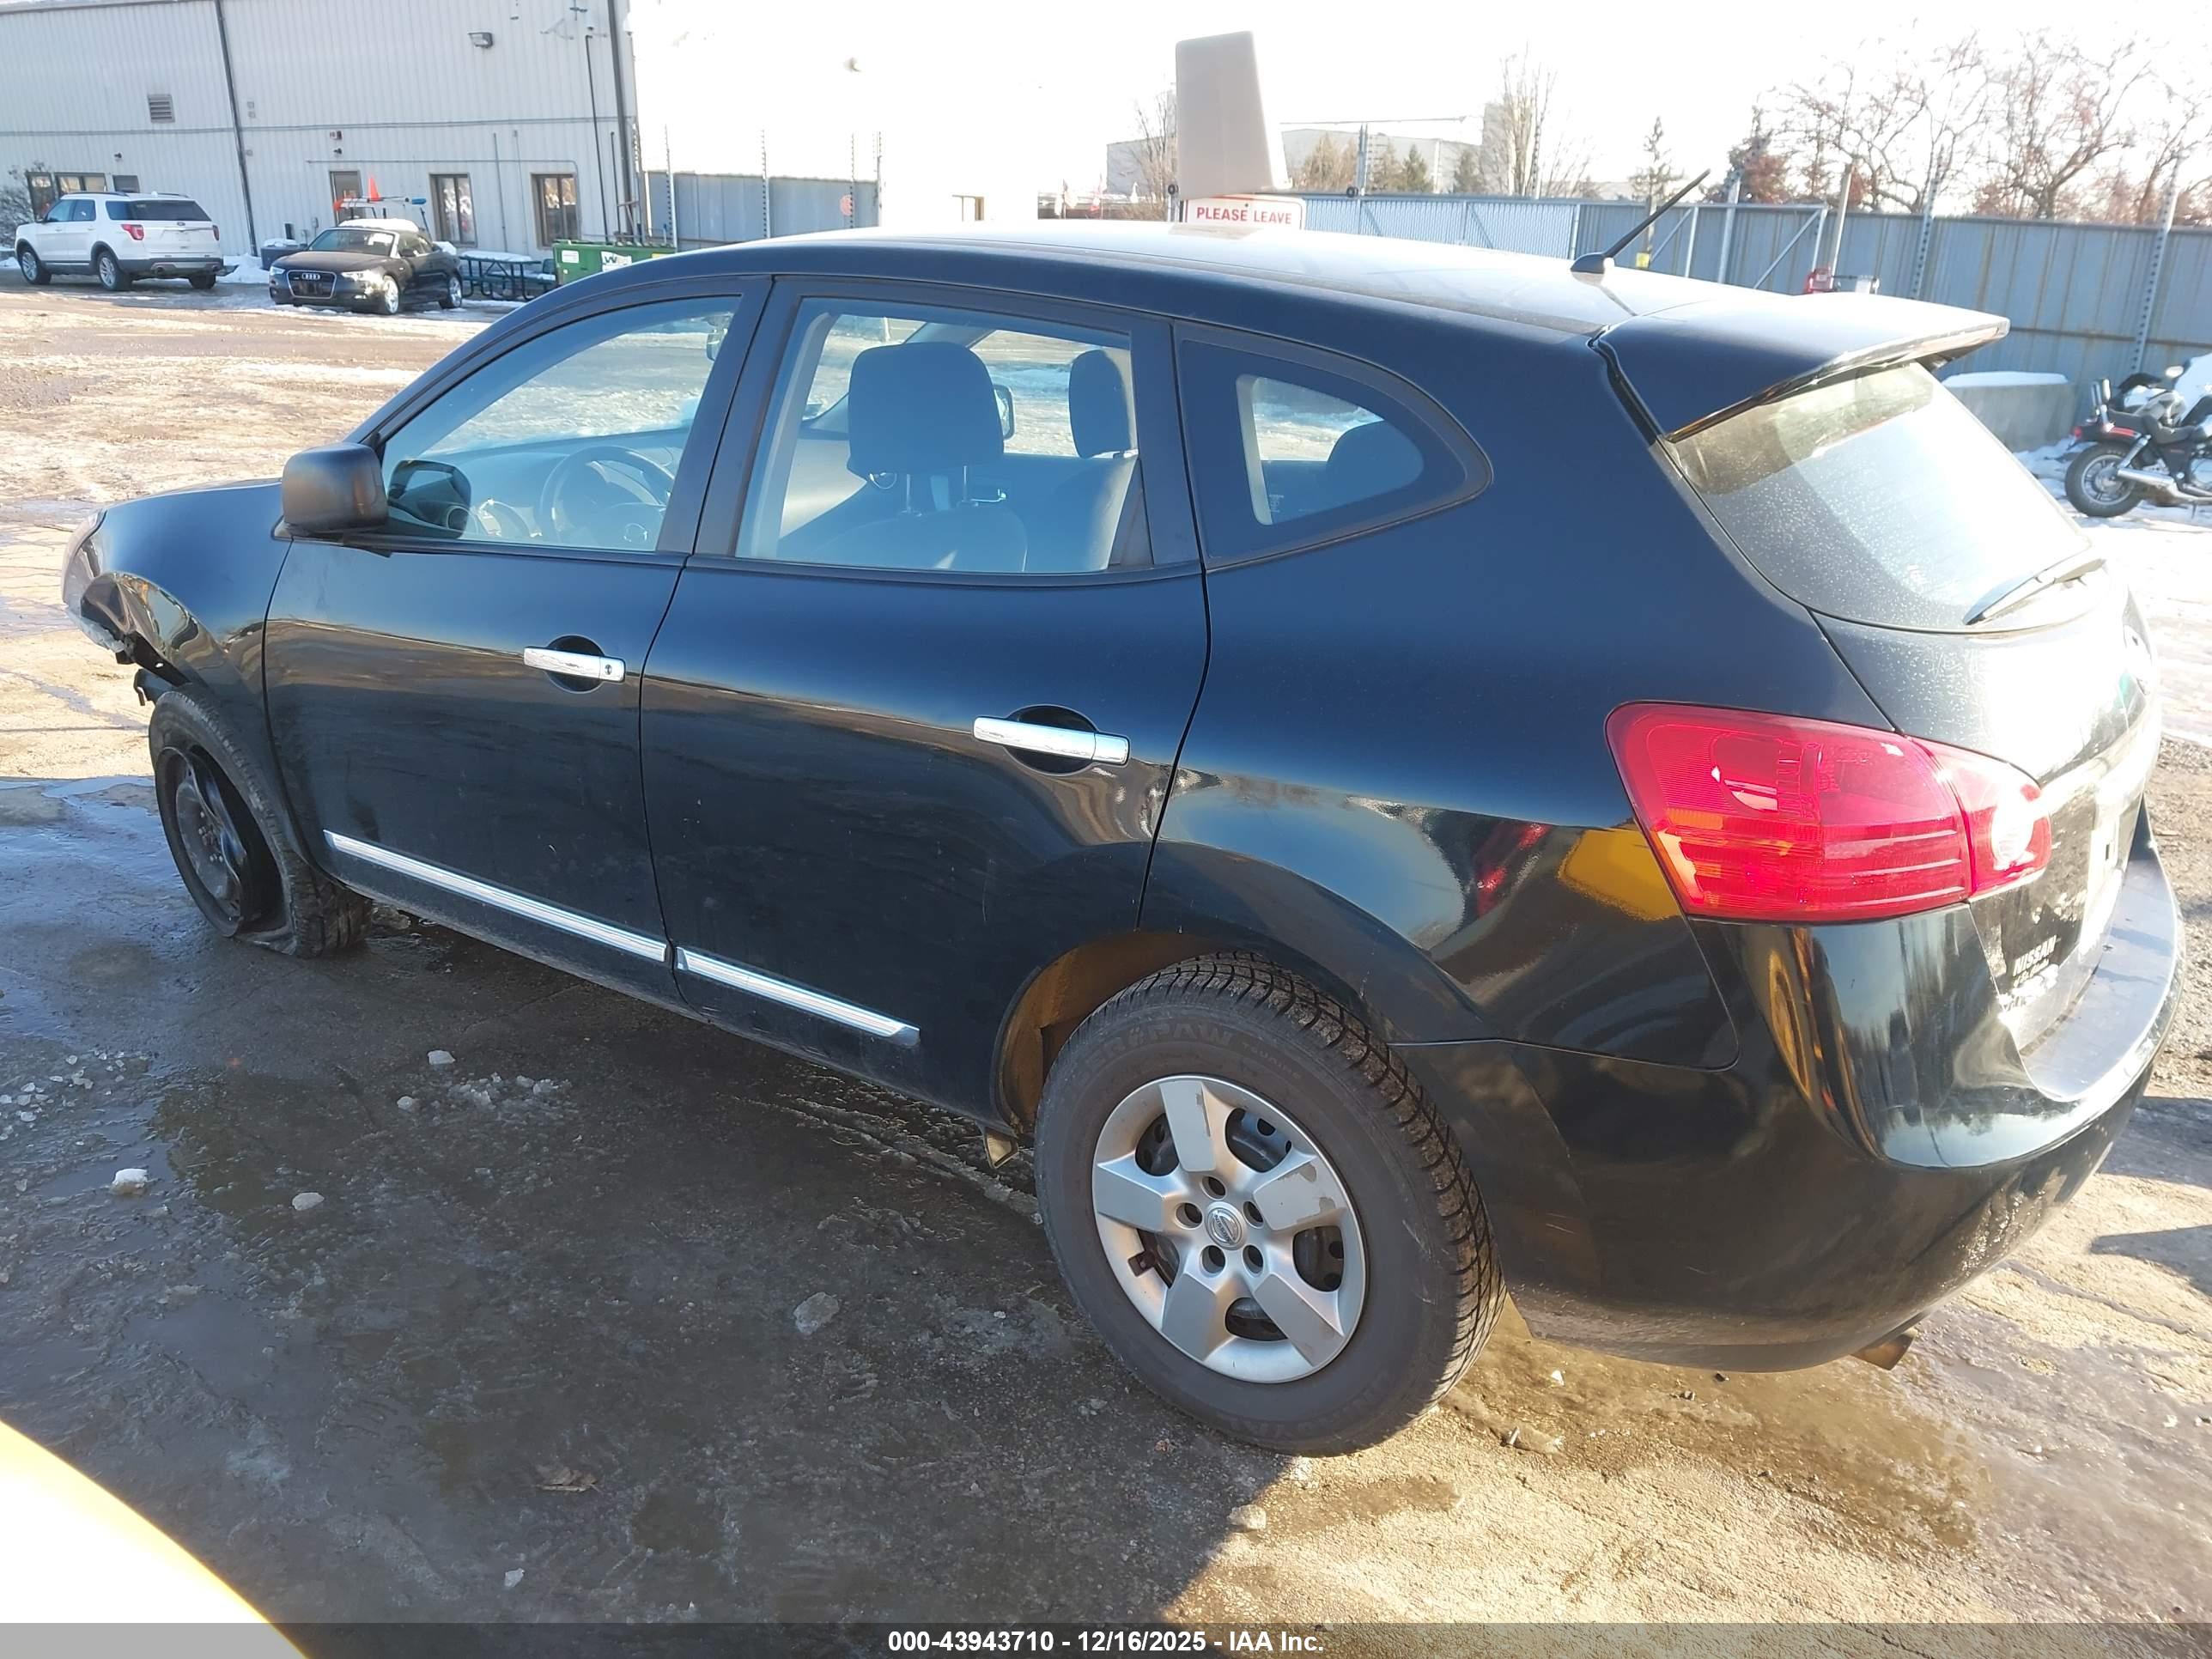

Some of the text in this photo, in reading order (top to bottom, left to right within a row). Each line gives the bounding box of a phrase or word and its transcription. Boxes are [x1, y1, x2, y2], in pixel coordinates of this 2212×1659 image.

[1196, 206, 1291, 224] PLEASE LEAVE
[2013, 935, 2057, 977] NISSAN
